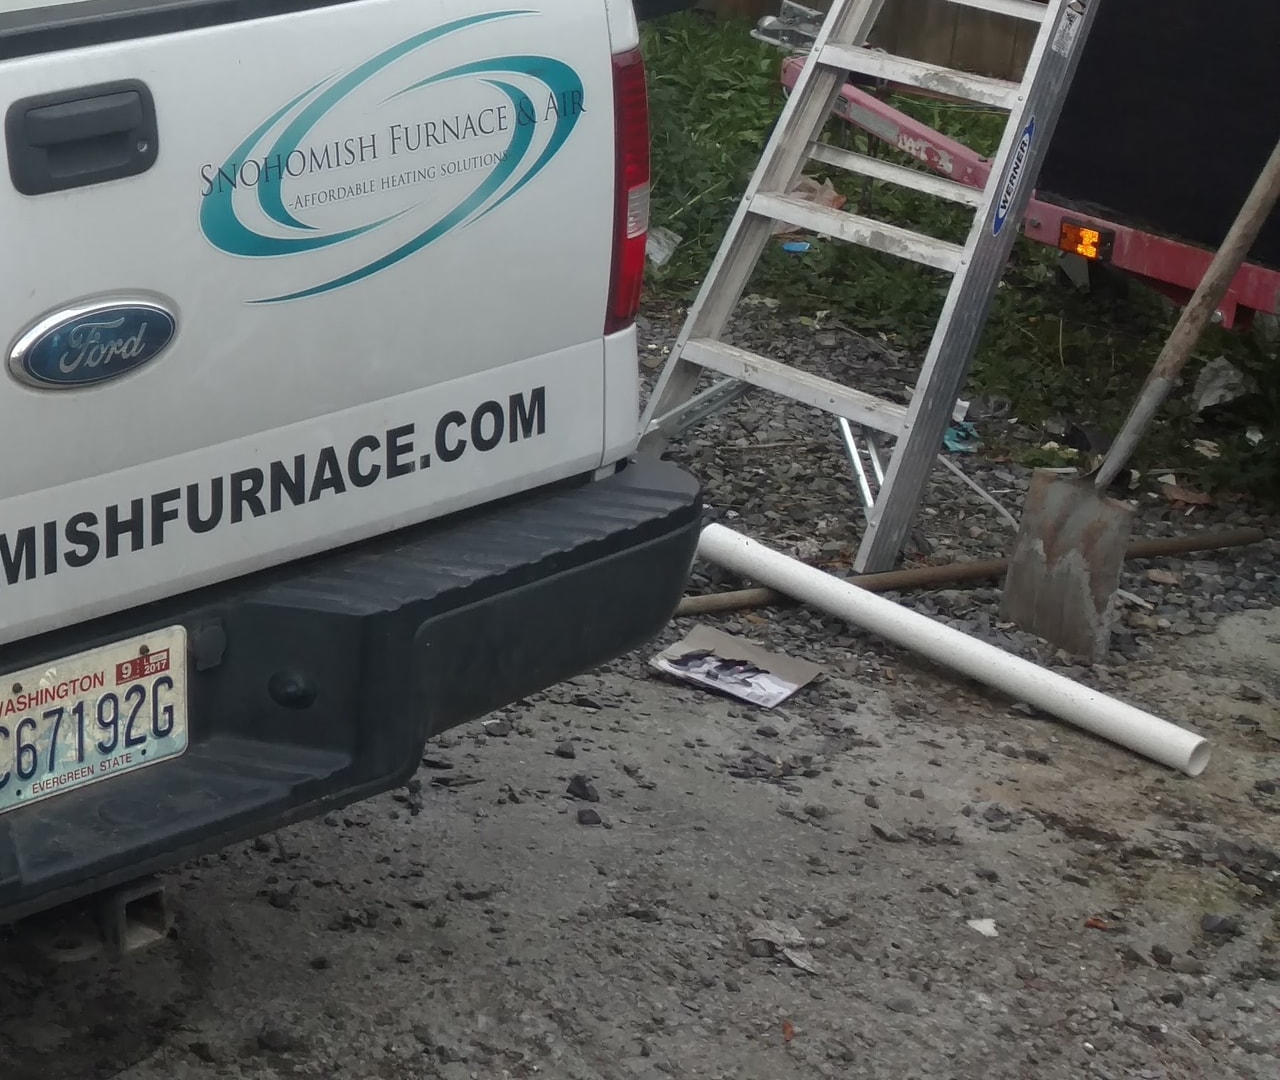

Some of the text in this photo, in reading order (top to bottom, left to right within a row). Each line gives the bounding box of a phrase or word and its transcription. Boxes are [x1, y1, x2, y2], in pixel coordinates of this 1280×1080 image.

[200, 90, 587, 197] SNOHOMISH FURNACE & AIR
[381, 165, 436, 190] HEATING
[1000, 138, 1029, 211] WERNER
[57, 317, 149, 377] Ford
[121, 662, 132, 679] 9
[144, 660, 167, 675] 2017
[32, 753, 132, 795] EVERGREEN STATE
